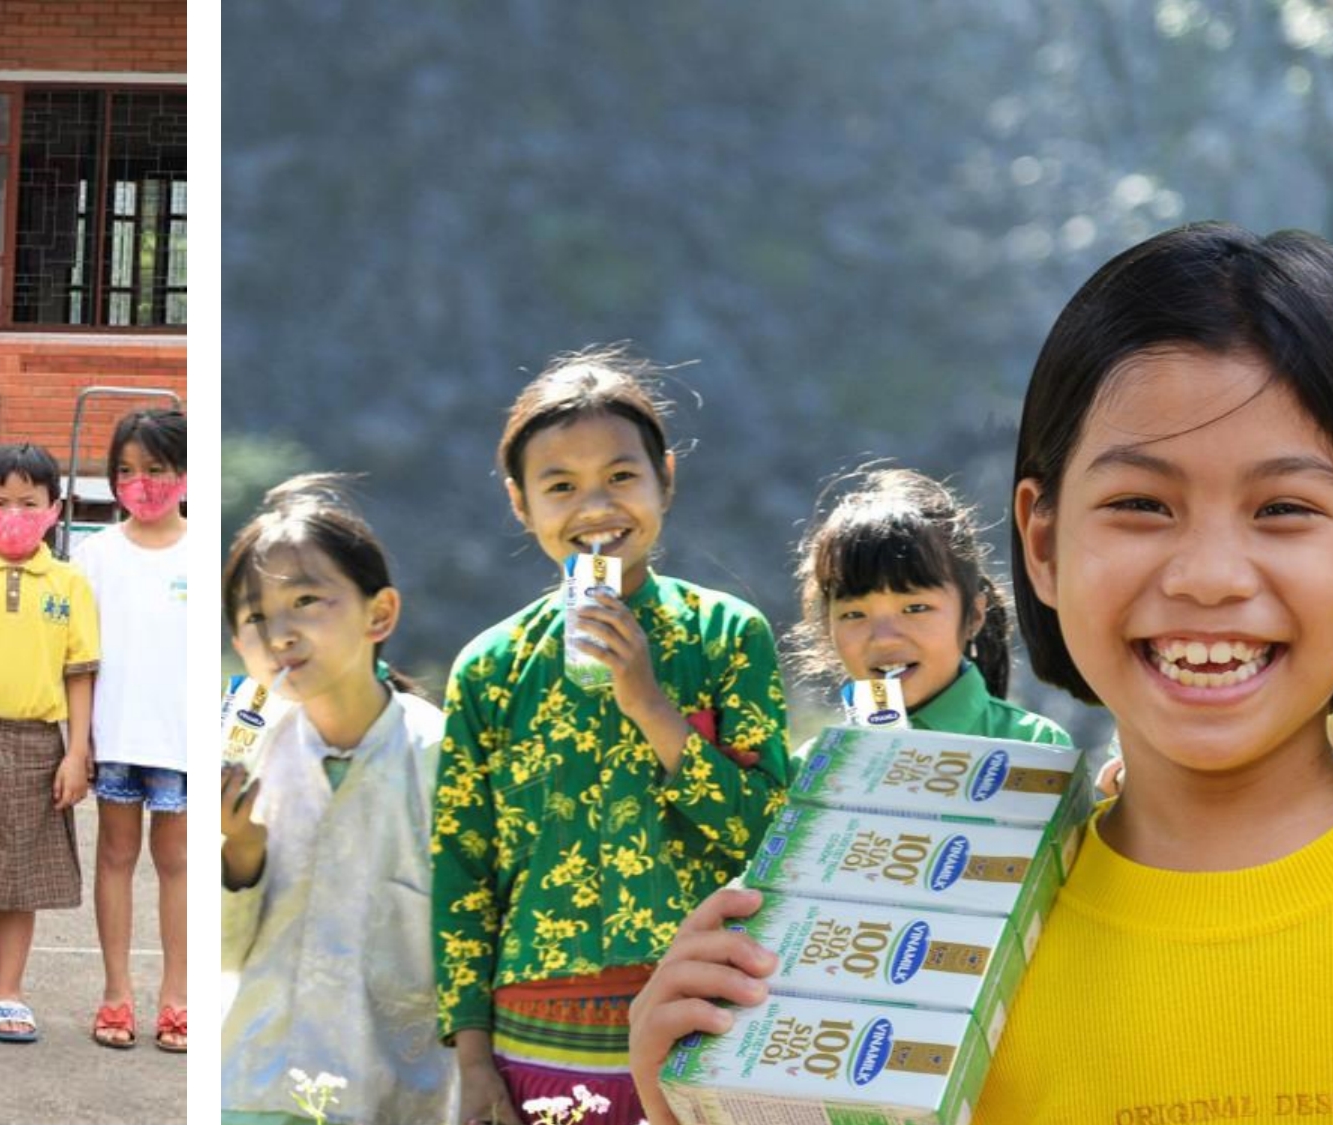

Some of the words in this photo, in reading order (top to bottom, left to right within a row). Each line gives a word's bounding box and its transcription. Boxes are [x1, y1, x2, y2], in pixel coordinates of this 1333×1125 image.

[930, 836, 970, 891] VINAMILK
[891, 921, 930, 984] VINAMILK
[853, 1018, 894, 1085] VINAMILK
